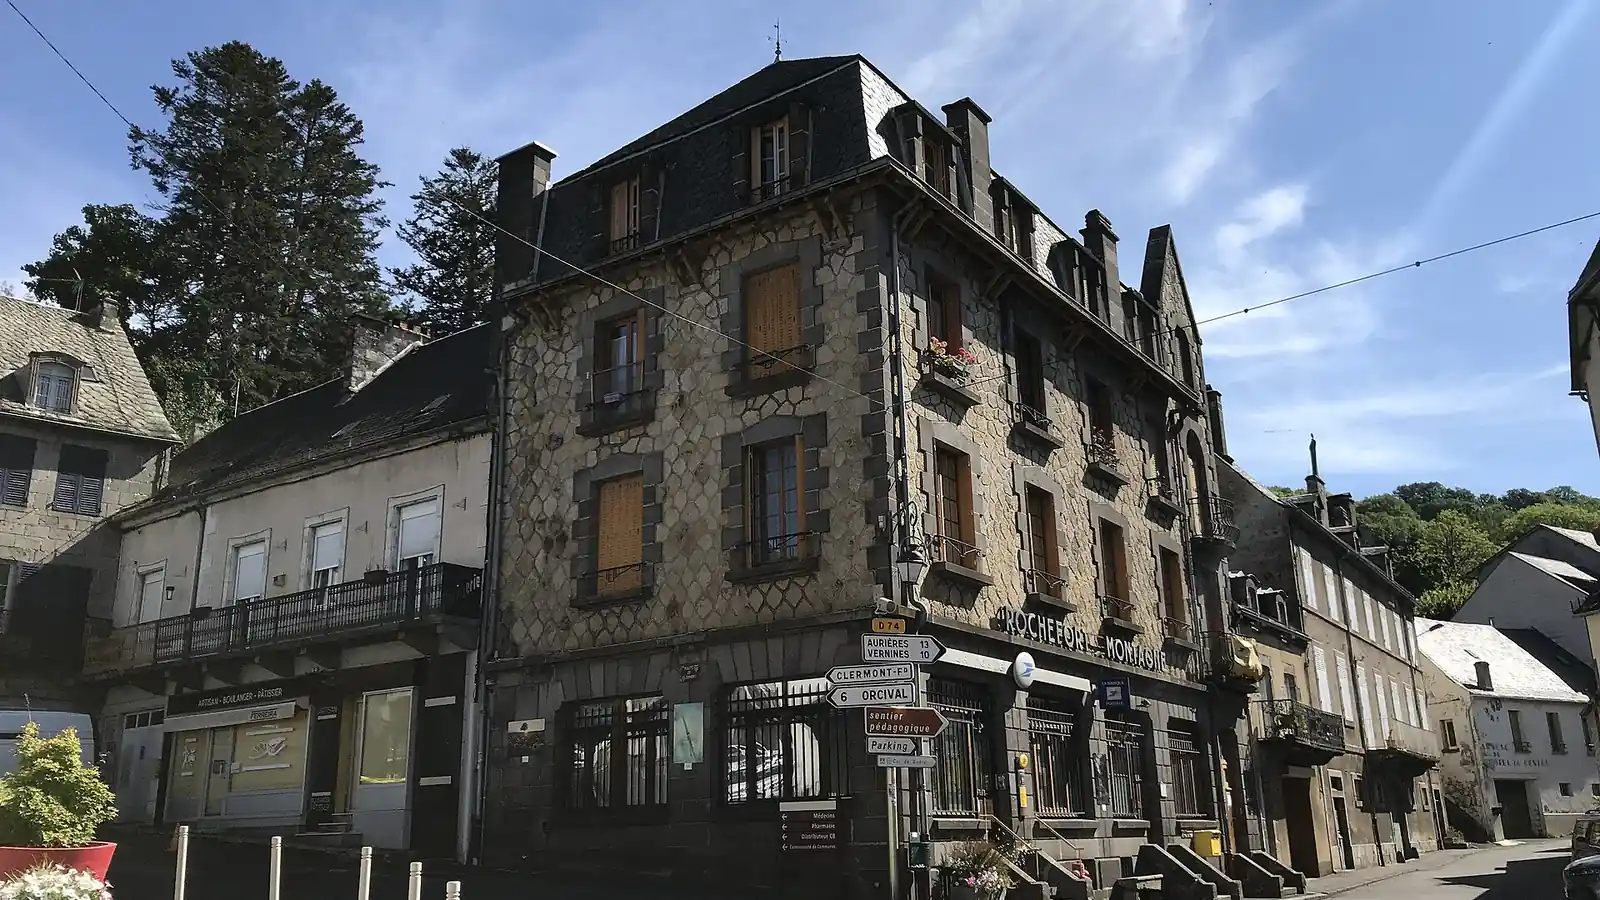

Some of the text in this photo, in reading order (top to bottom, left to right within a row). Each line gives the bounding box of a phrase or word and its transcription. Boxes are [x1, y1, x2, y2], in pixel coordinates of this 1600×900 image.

[878, 622, 900, 630] D 74
[1005, 608, 1090, 650] ROCHEFORT
[867, 638, 929, 649] AURIÈRES 13
[867, 650, 930, 659] VERNINES 10
[197, 698, 218, 708] ARTISAN
[222, 693, 253, 704] BOULANGER
[840, 688, 908, 702] 6 ORCIVAL
[869, 712, 904, 721] sentier
[869, 722, 930, 734] pédagogique
[871, 740, 908, 752] Parking
